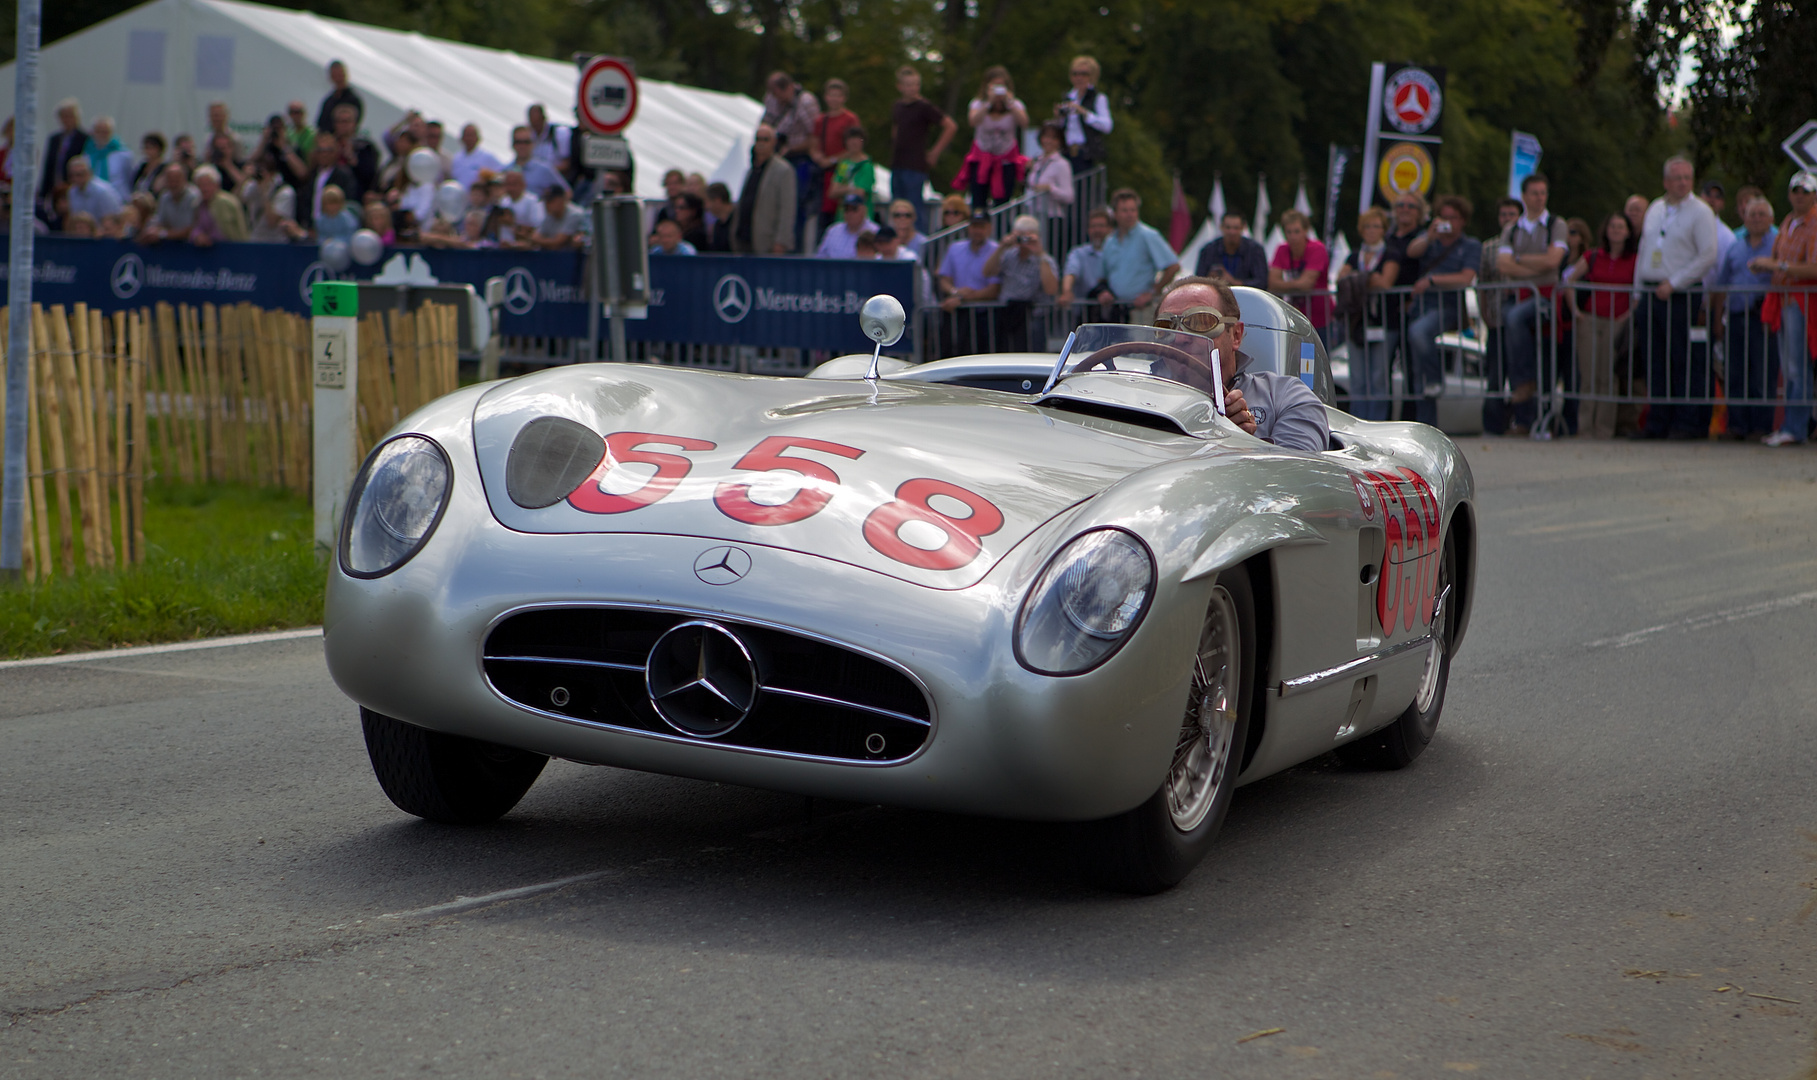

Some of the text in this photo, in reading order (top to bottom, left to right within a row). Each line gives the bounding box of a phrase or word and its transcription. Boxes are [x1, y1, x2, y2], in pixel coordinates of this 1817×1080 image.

[755, 286, 868, 314] Mercedes-Be
[323, 341, 334, 360] 4
[565, 431, 1005, 571] 658
[1361, 466, 1441, 638] 658
